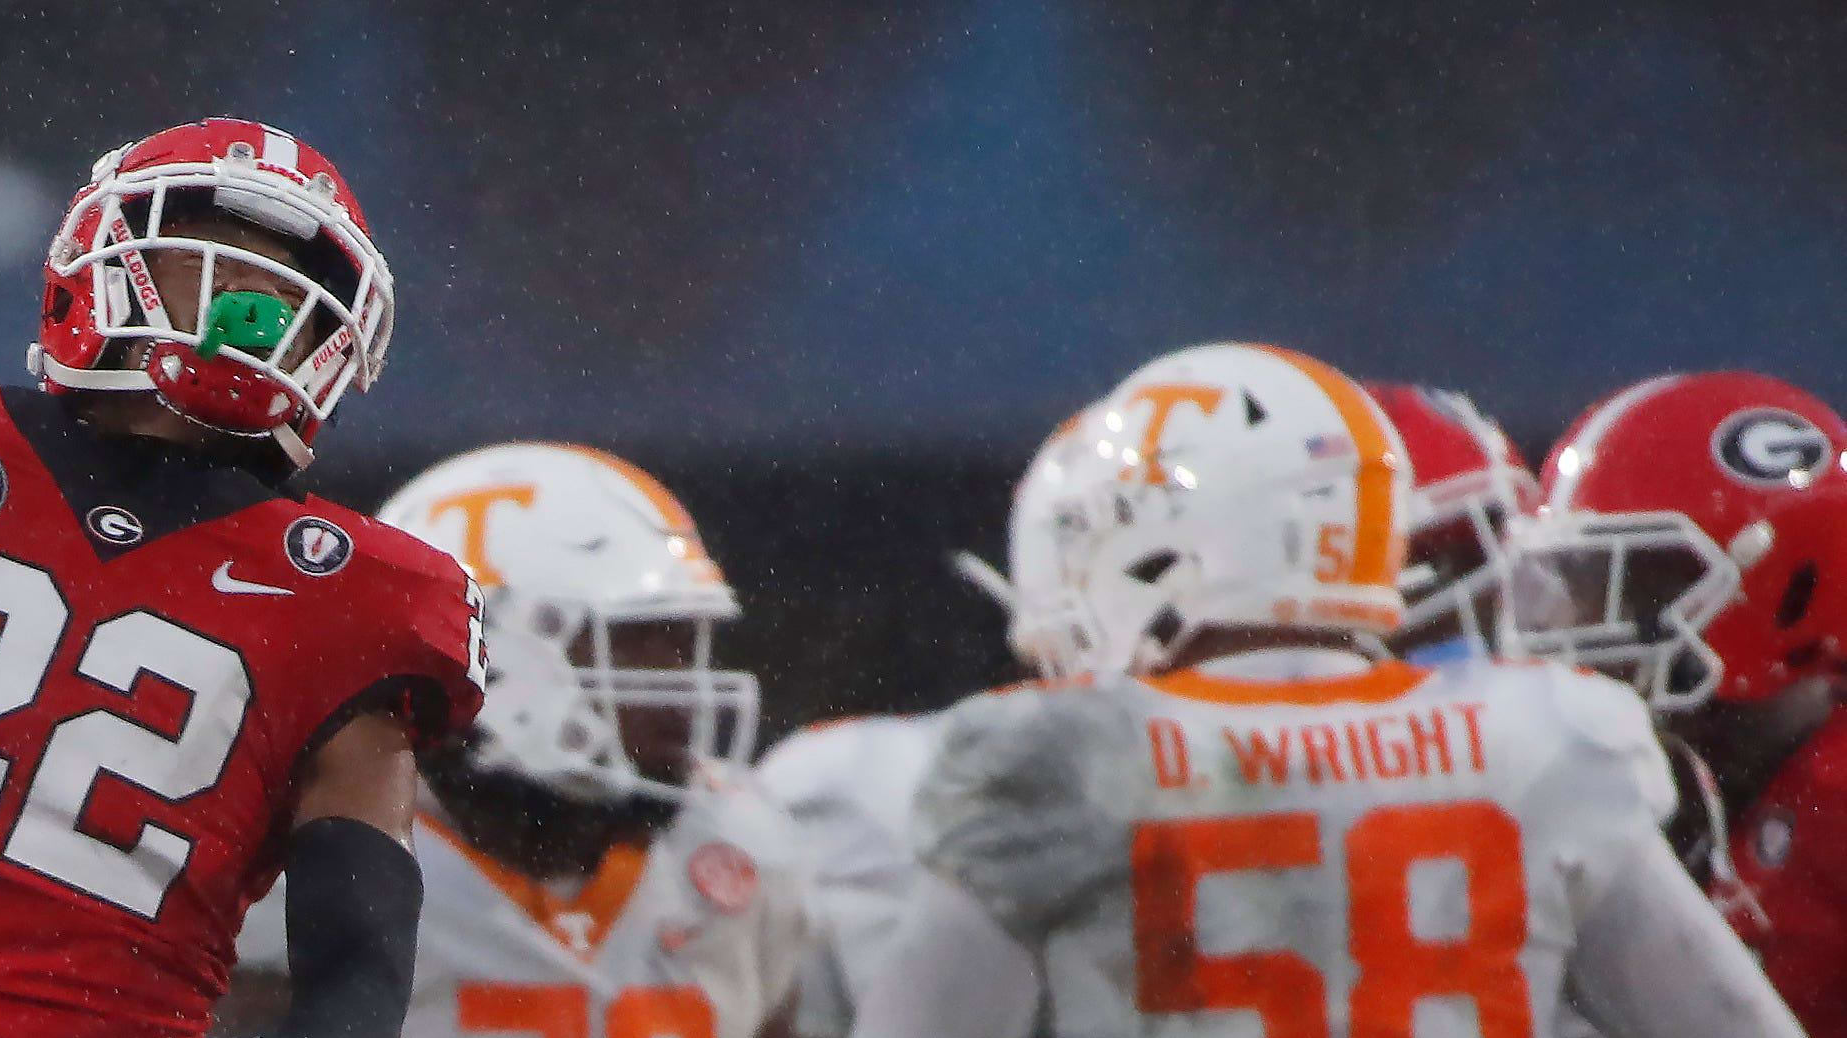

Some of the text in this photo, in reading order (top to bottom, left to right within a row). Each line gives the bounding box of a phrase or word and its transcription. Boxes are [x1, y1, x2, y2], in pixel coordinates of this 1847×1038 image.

[1723, 412, 1828, 478] G
[92, 508, 143, 541] G
[425, 485, 537, 588] T
[1147, 702, 1490, 790] D. WRIGHT
